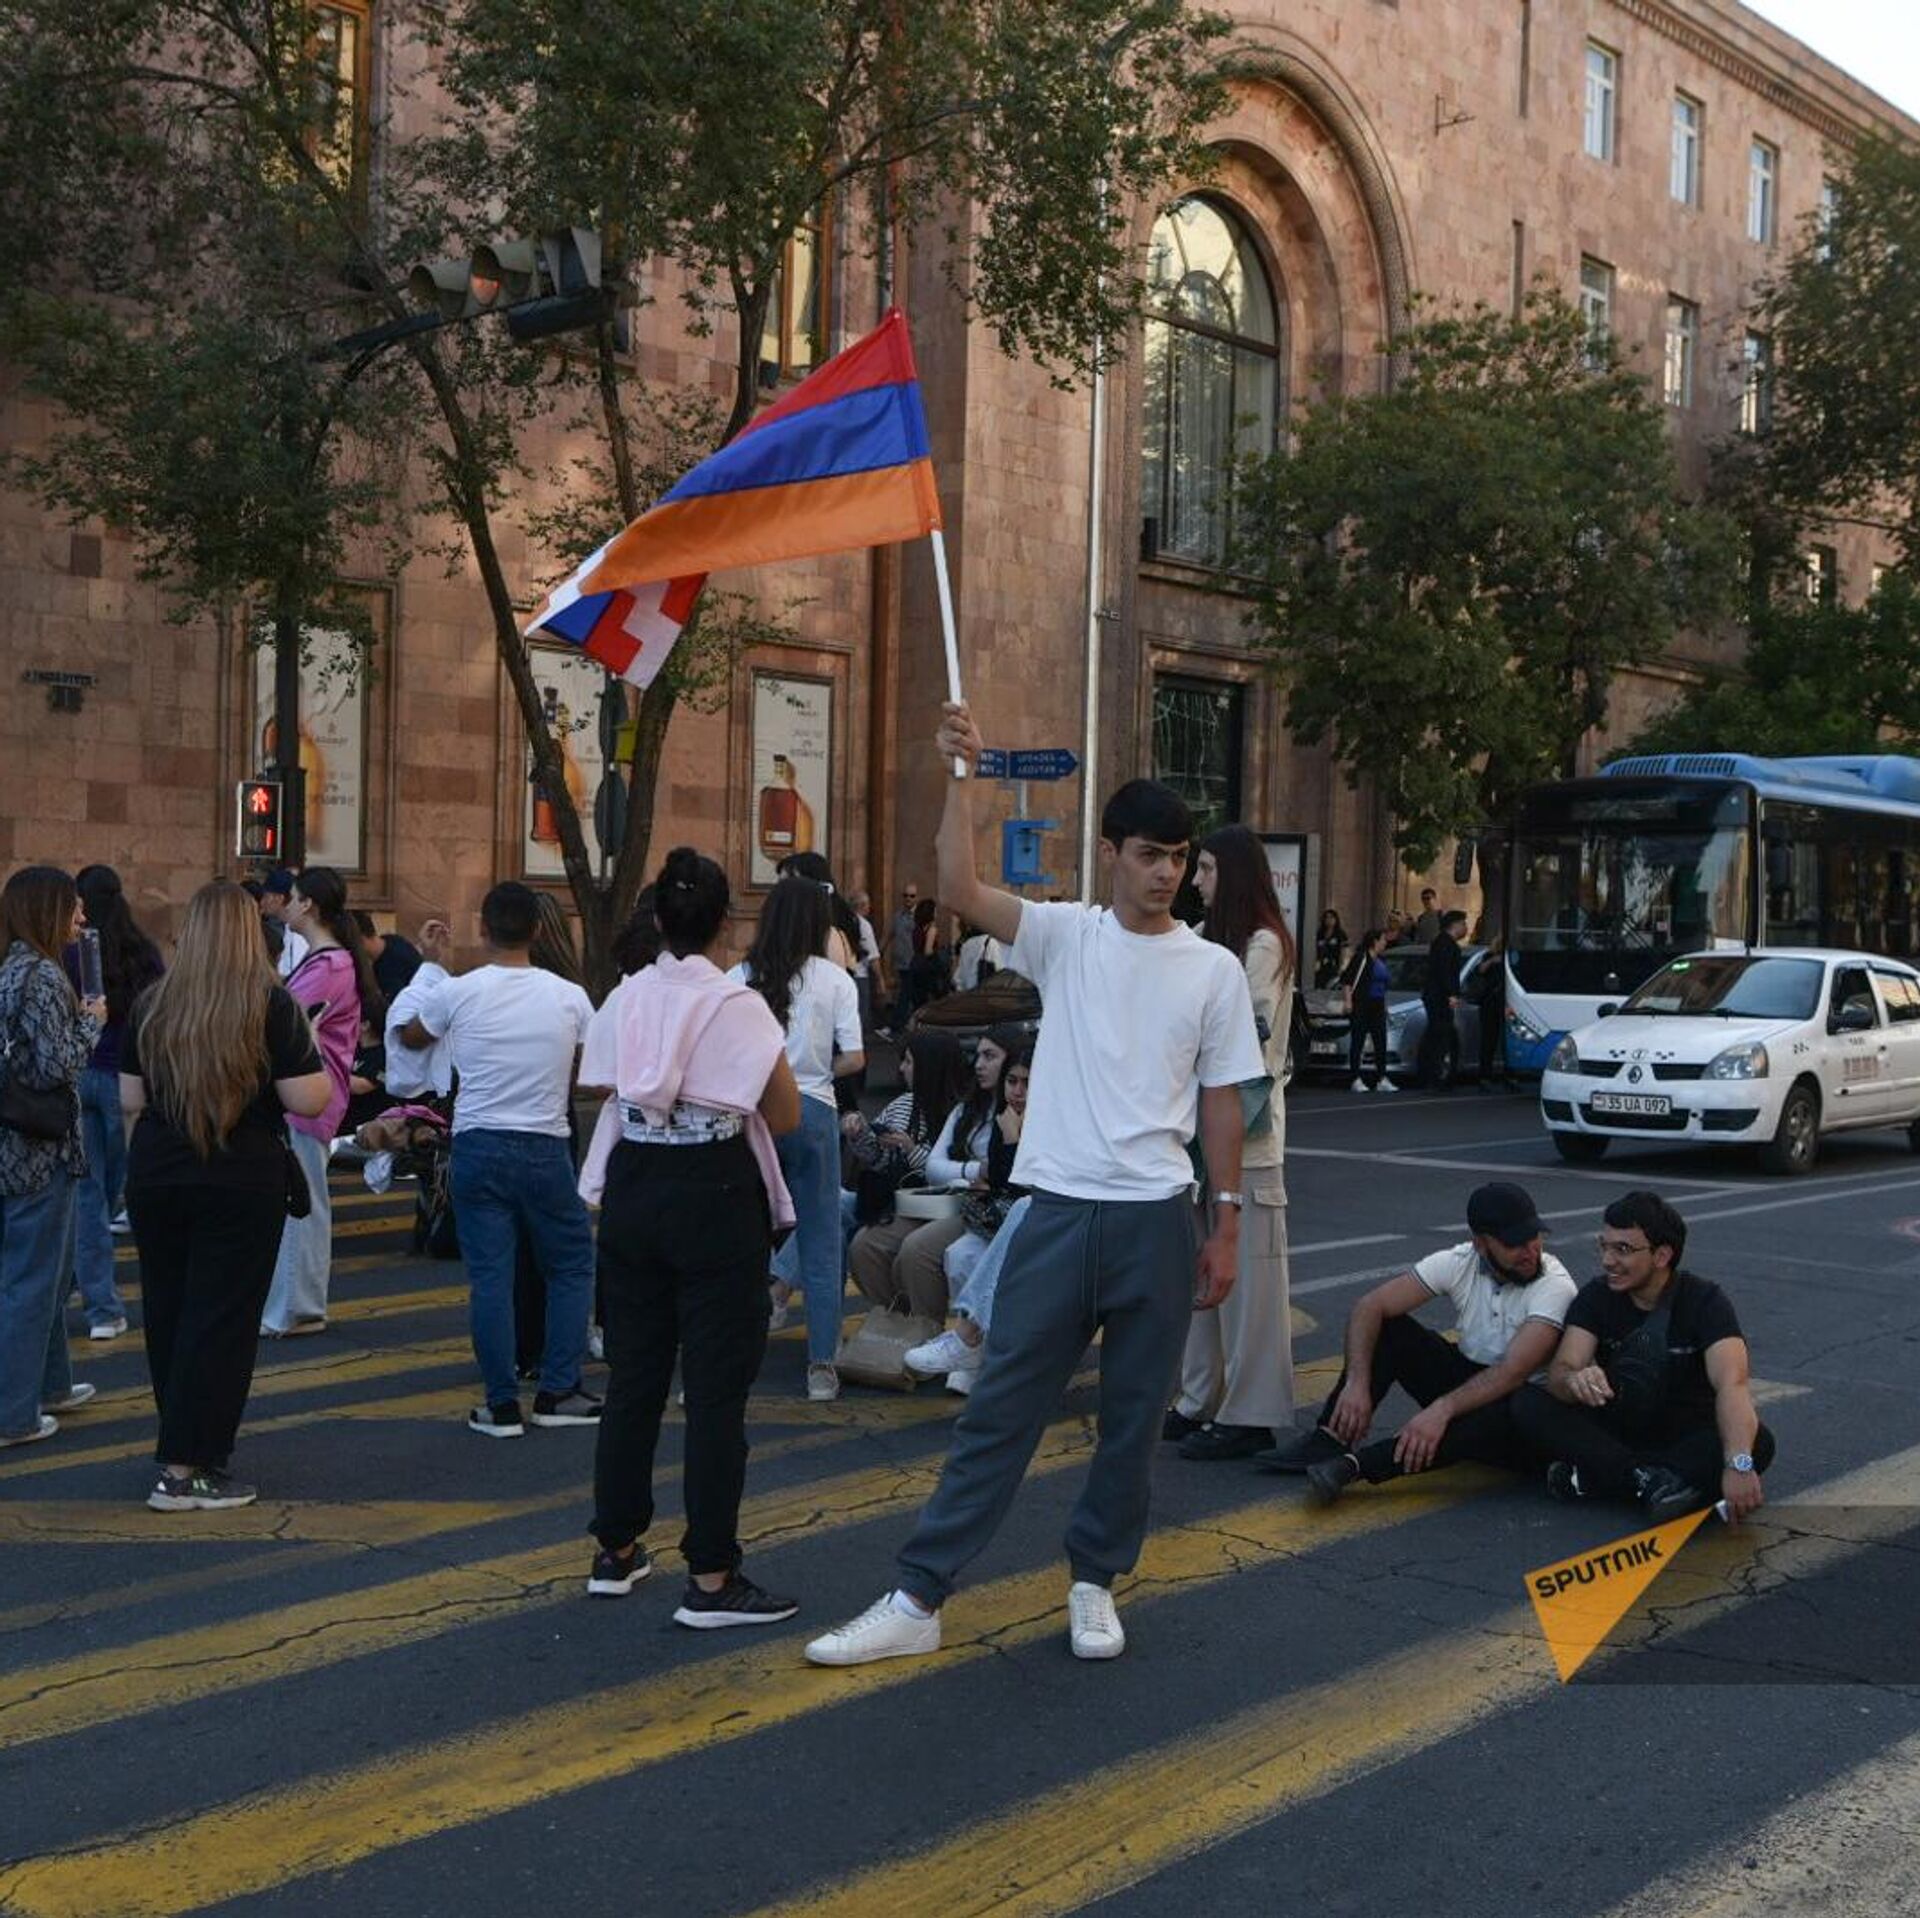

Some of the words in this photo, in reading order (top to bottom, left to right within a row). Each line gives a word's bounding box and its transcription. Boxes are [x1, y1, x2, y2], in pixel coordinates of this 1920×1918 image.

[1608, 1097, 1622, 1110] 35
[1624, 1098, 1641, 1111] UA
[1644, 1099, 1666, 1113] 092
